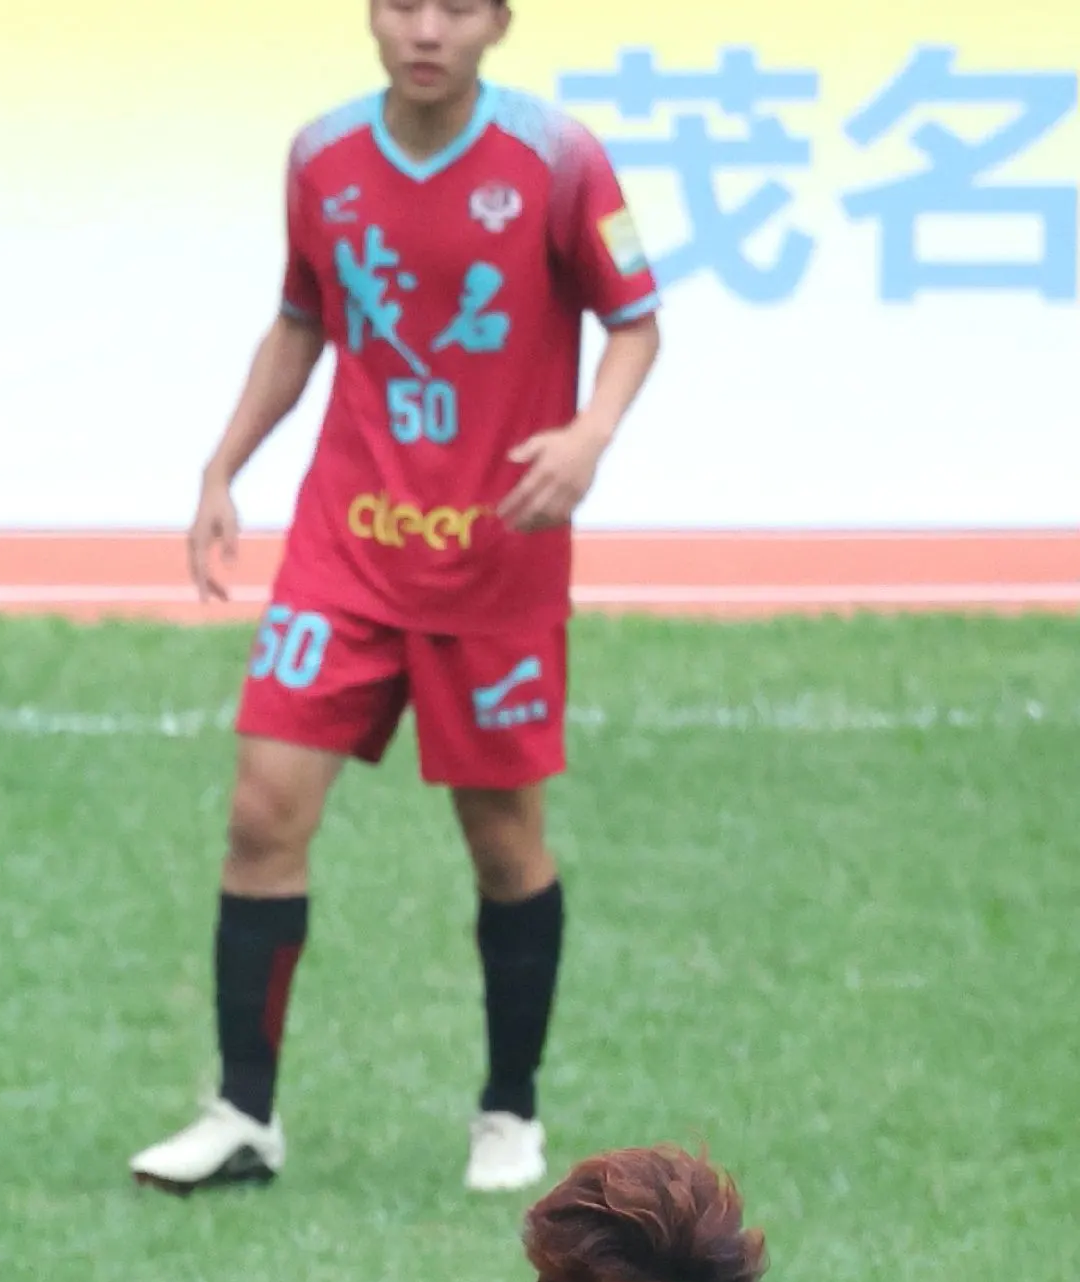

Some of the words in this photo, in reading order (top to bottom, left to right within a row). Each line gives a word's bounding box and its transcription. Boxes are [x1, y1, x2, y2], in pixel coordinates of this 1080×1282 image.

[555, 47, 1078, 303] 茂名
[386, 380, 458, 444] 50
[251, 604, 331, 689] 50
